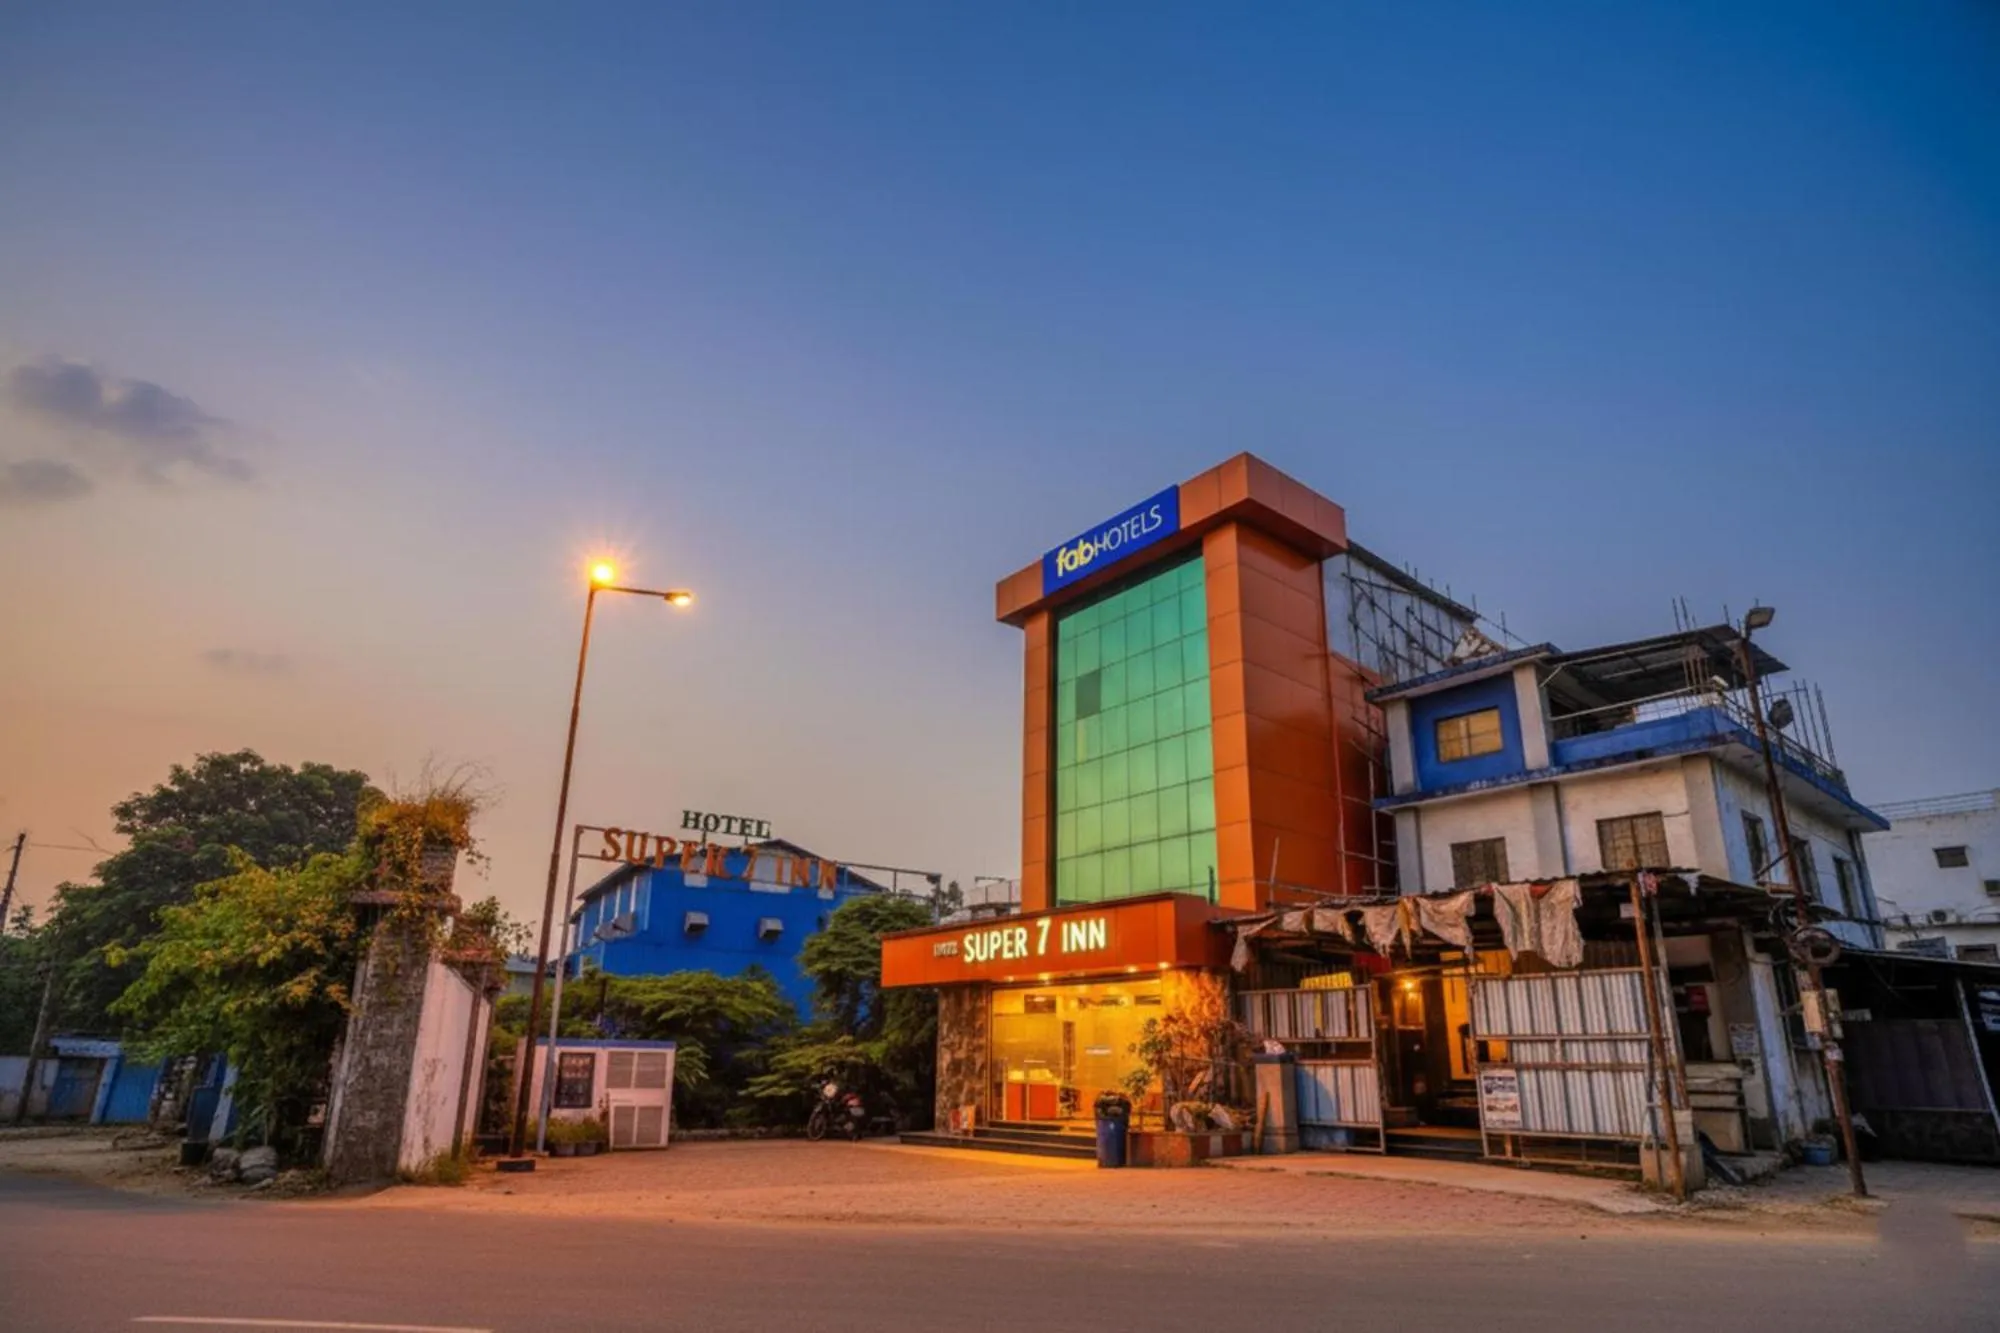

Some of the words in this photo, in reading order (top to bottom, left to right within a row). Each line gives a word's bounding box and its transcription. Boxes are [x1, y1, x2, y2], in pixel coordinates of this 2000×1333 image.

[681, 810, 771, 839] HOTEL
[601, 827, 731, 879] SUPER
[775, 854, 837, 890] INN
[963, 927, 1028, 963] SUPER
[1036, 916, 1051, 956] 7
[1062, 917, 1106, 953] INN
